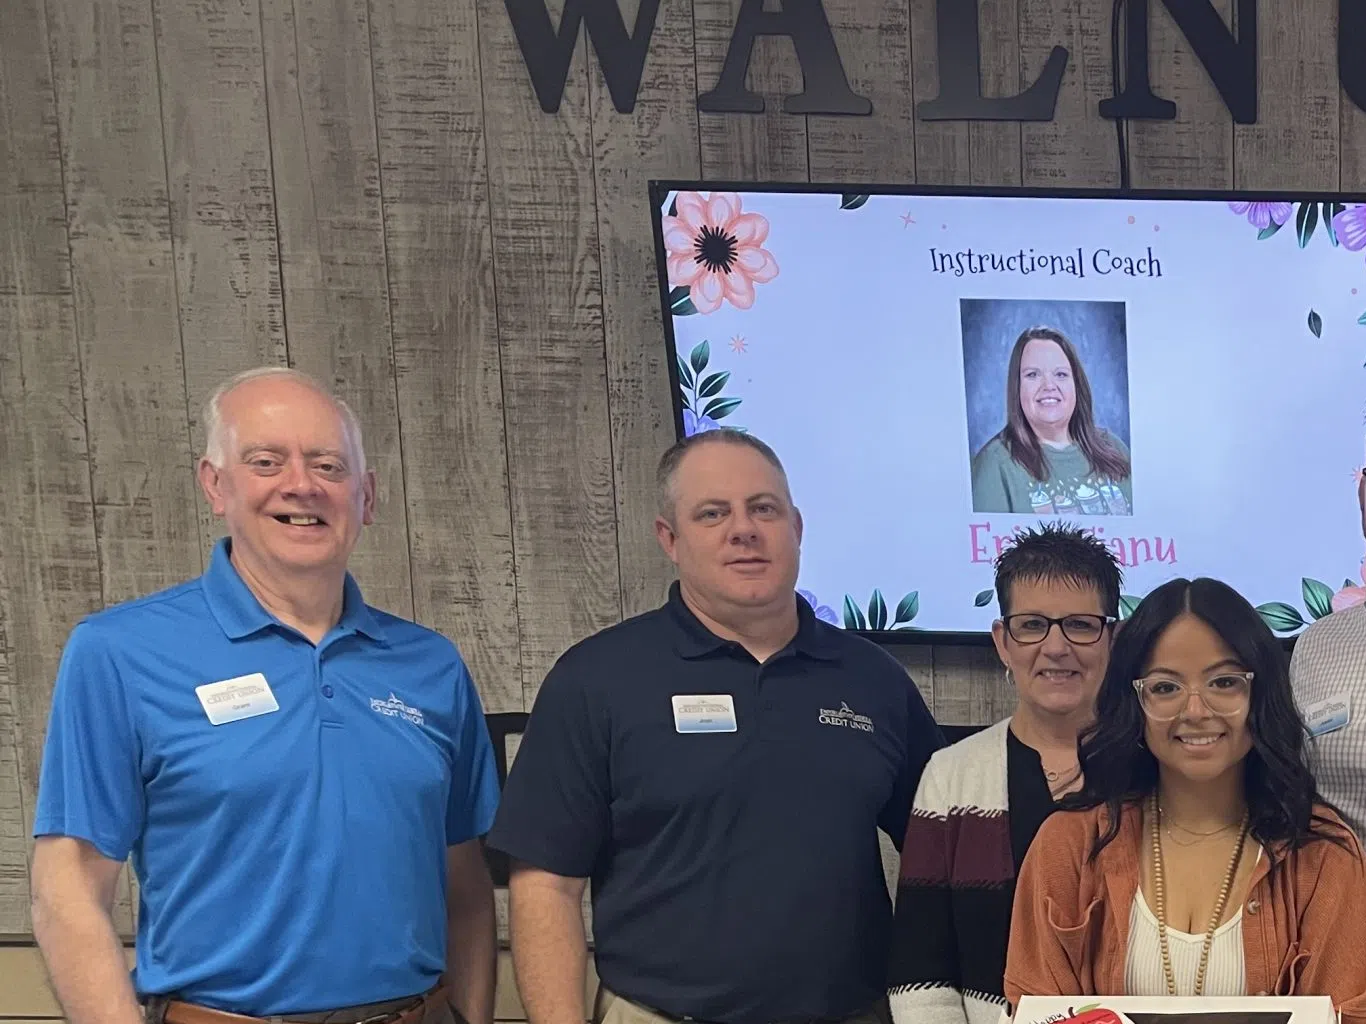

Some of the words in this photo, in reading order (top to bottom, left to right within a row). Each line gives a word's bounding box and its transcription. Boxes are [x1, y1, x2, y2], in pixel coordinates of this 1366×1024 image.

[928, 247, 1086, 278] Instructional
[1091, 246, 1163, 278] Coach
[818, 714, 848, 727] CREDIT
[849, 720, 875, 733] UNION
